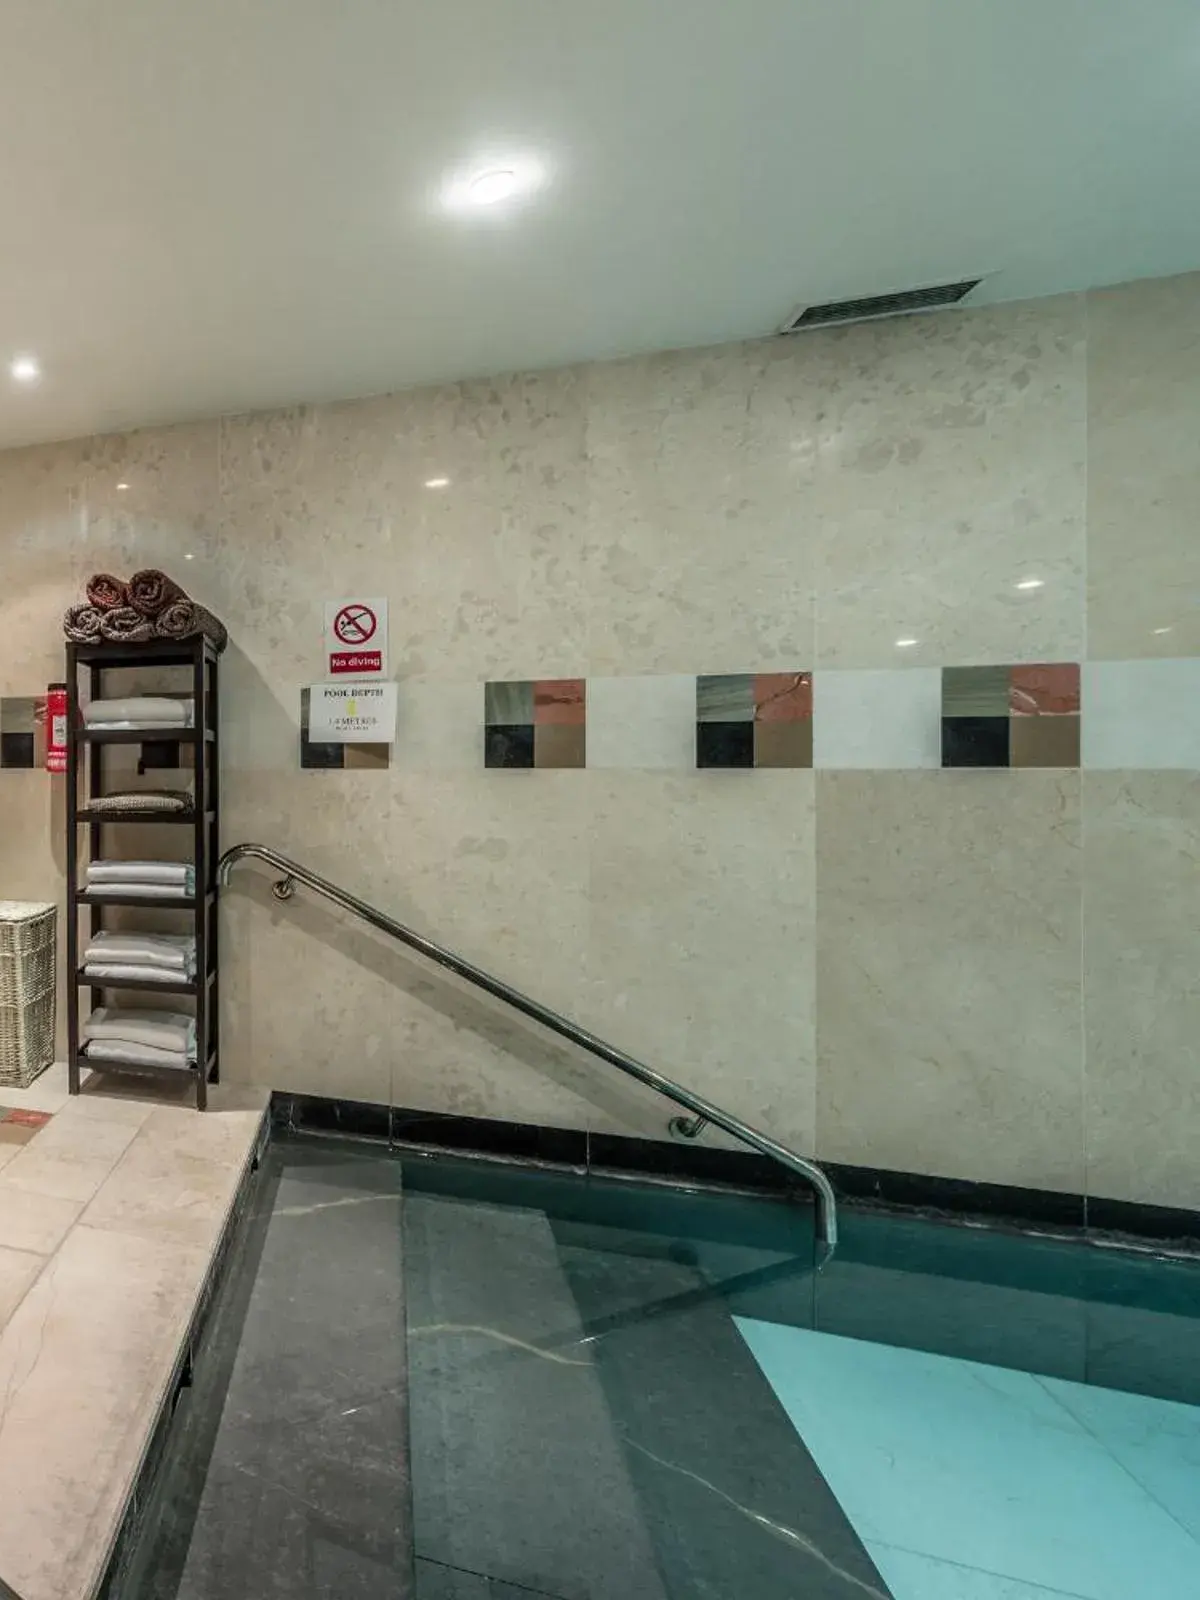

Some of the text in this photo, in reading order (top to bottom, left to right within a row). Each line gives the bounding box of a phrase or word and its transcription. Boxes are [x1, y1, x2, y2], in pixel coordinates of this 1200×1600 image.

[332, 657, 380, 667] No diving
[324, 688, 383, 697] POOL DEPTH
